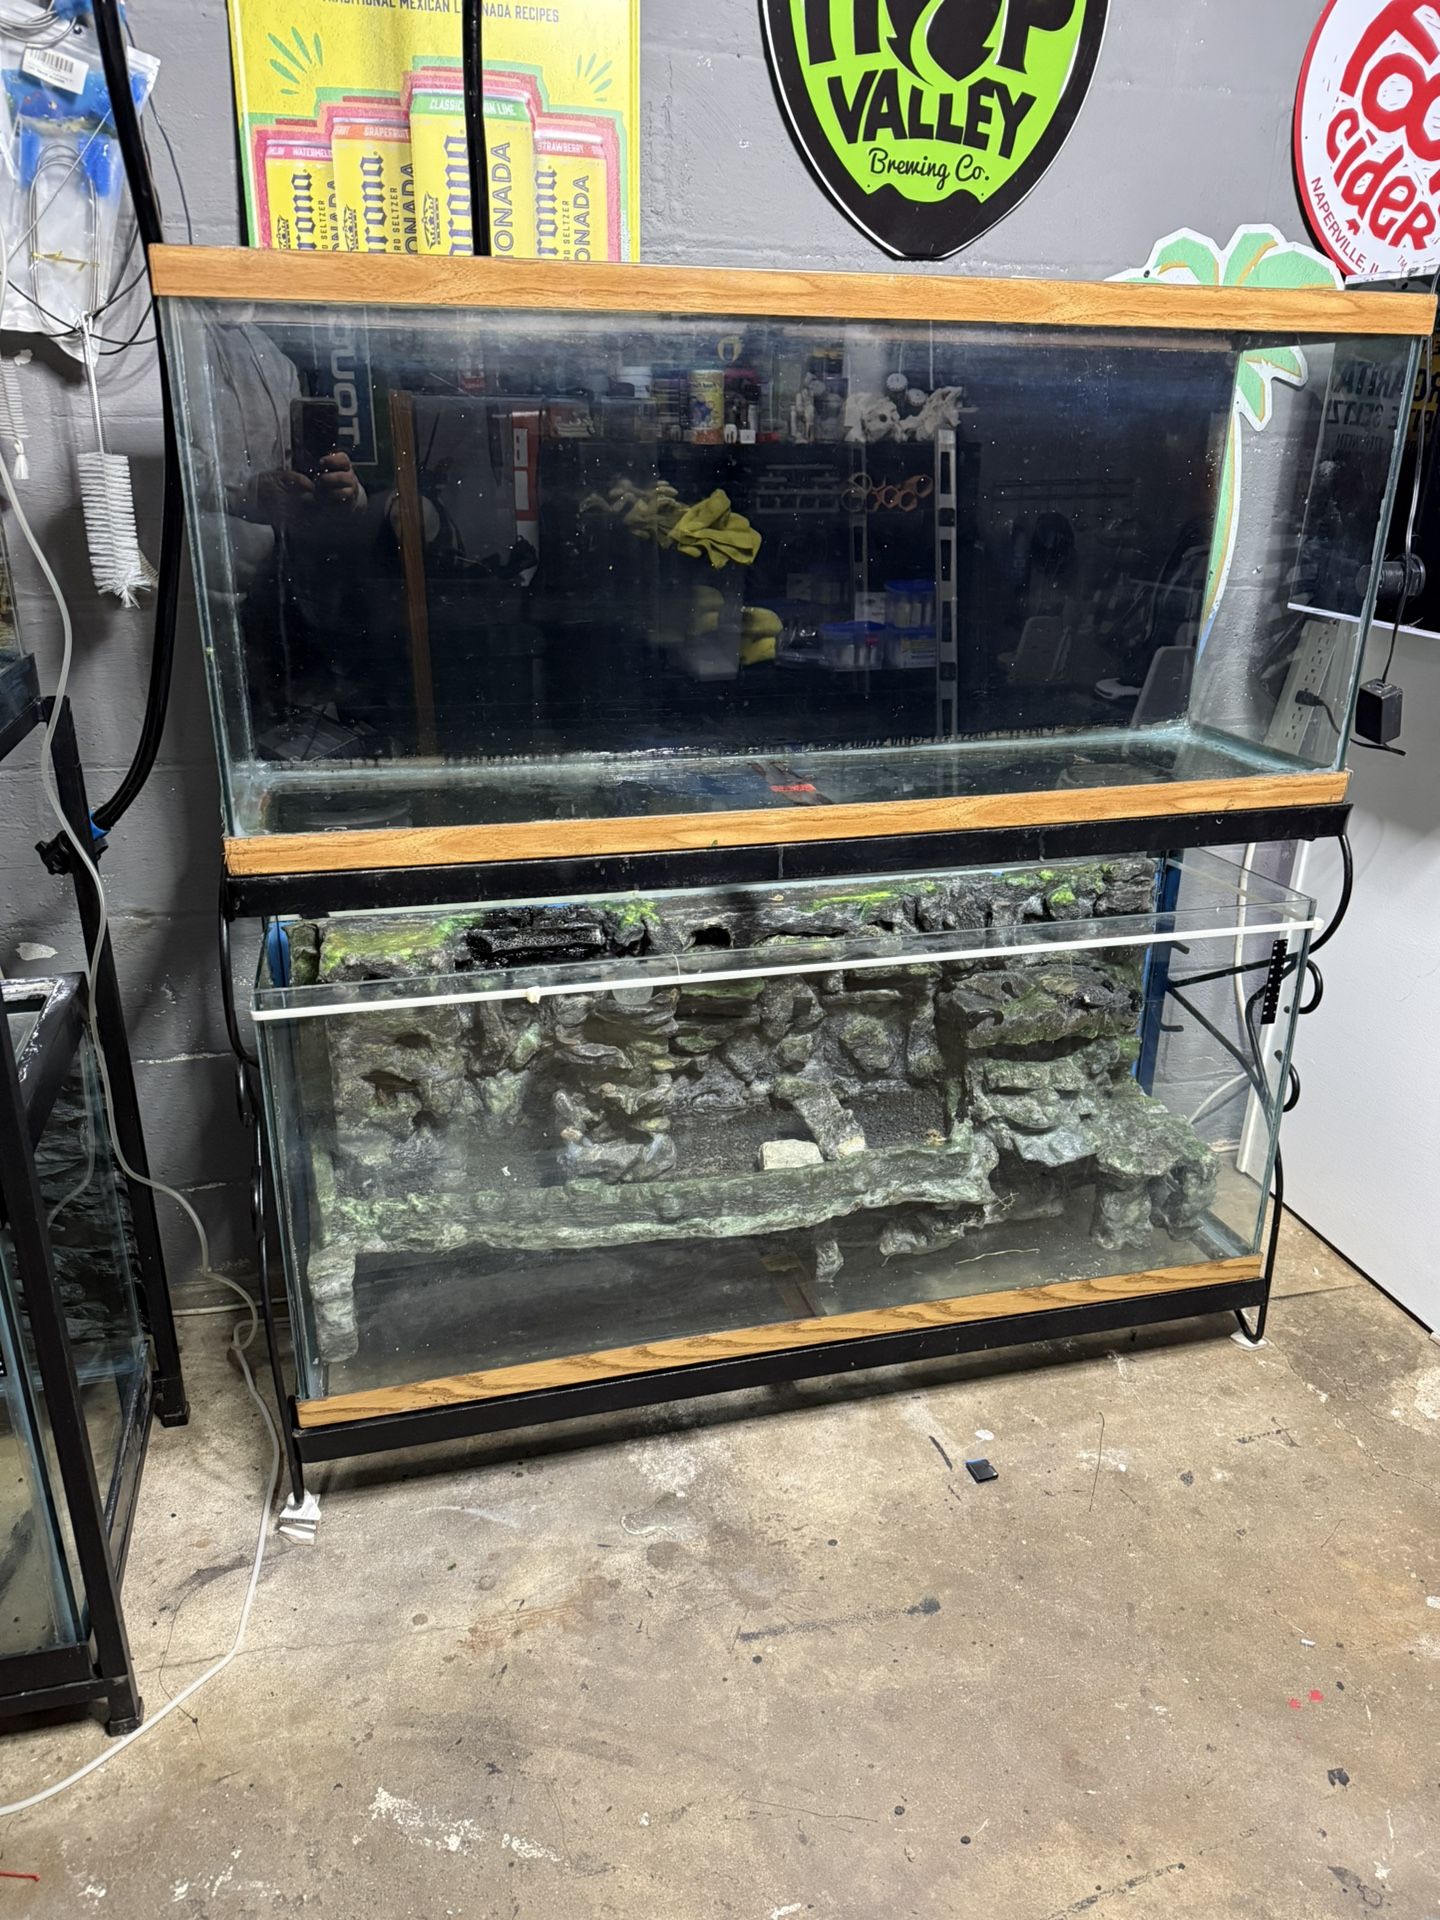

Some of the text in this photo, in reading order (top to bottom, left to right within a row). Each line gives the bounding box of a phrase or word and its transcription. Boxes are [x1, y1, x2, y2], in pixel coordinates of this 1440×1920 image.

[400, 0, 450, 13] MEXICAN
[515, 5, 559, 22] RECIPES
[827, 68, 1037, 160] VALLEY
[536, 142, 584, 155] STRAWBERRY
[868, 147, 991, 191] Brewing Co.
[318, 200, 329, 240] SELTZER
[390, 187, 400, 233] SELTZER
[562, 200, 571, 244] SELTZER
